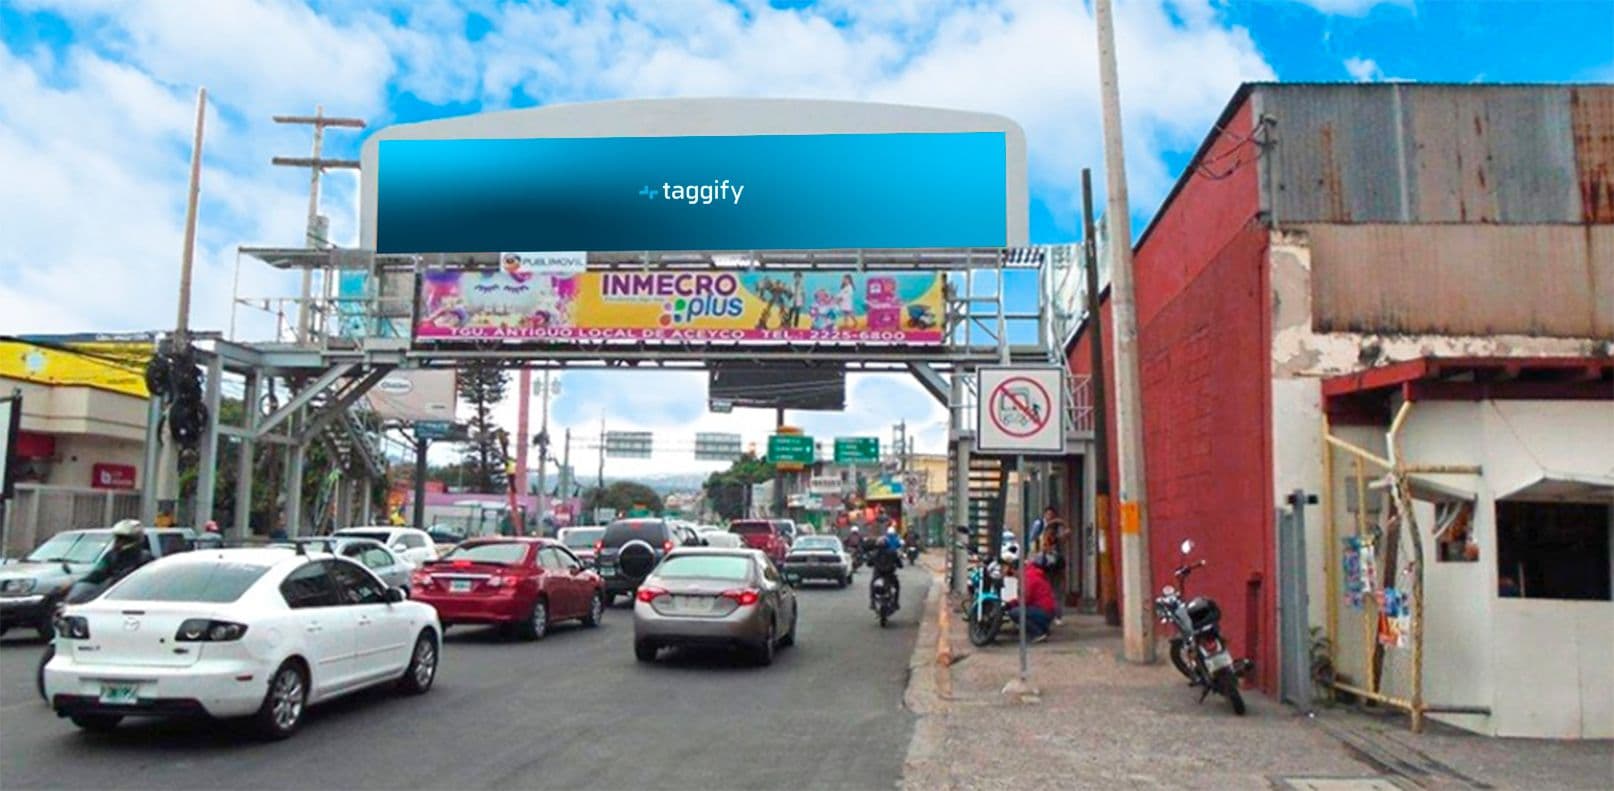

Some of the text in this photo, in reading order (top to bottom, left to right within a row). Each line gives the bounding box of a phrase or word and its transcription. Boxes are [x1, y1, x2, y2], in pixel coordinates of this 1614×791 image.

[662, 179, 744, 205] taggify
[602, 273, 738, 296] INMECRO
[686, 292, 744, 323] plus
[450, 328, 488, 338] TGU.
[494, 327, 573, 338] ANTIGUO
[578, 328, 637, 339] LOCAL
[642, 328, 663, 339] DE
[670, 329, 746, 340] ACEYCO
[810, 330, 906, 341] 2225-6800
